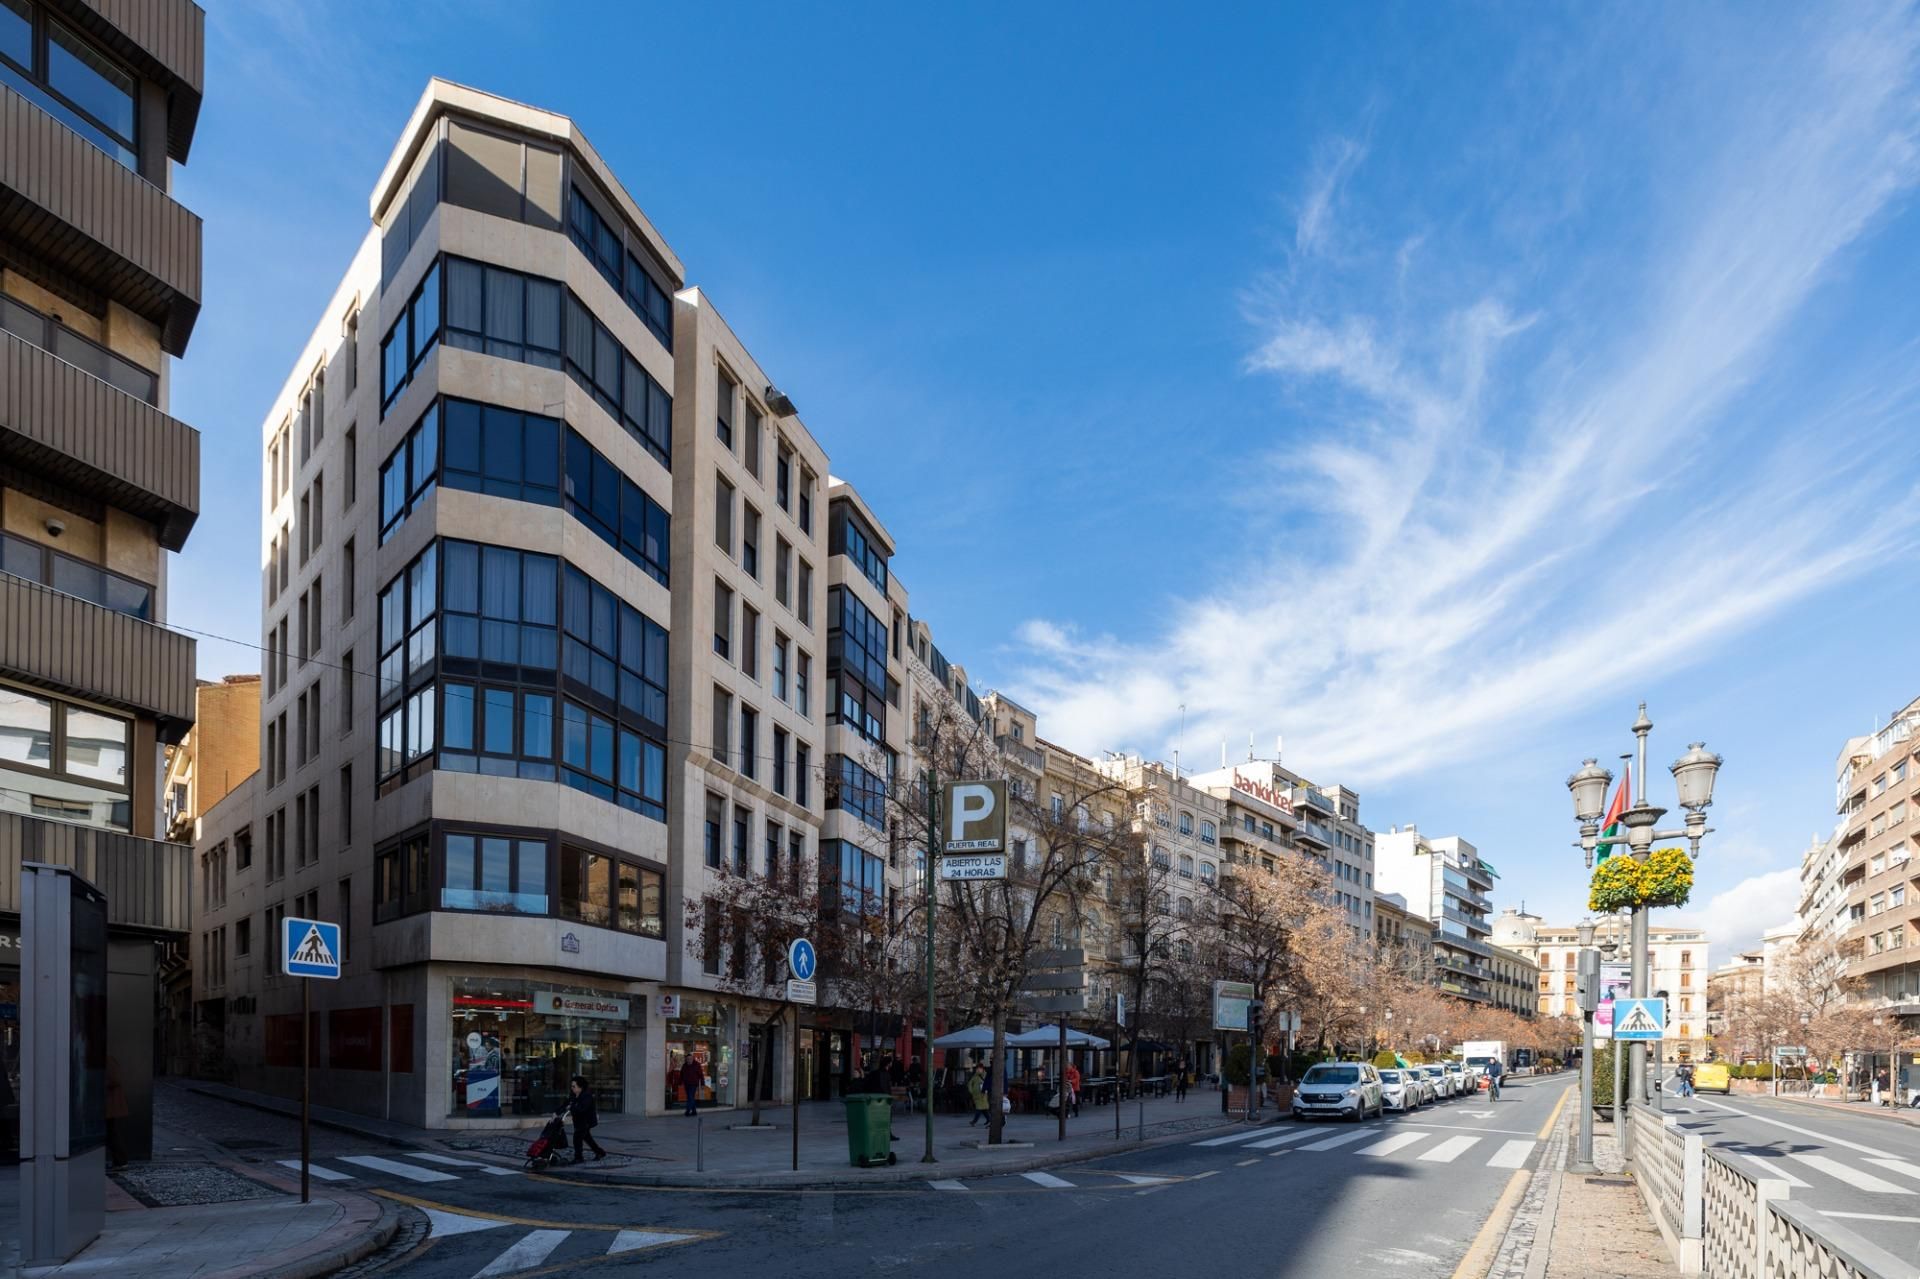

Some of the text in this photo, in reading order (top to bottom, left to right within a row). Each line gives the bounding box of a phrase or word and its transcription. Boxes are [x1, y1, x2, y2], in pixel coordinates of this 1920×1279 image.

[951, 784, 995, 840] P
[948, 840, 997, 849] PUERTA REAL
[946, 857, 1002, 867] ABIERTO LAS
[951, 868, 996, 877] 24 HORAS
